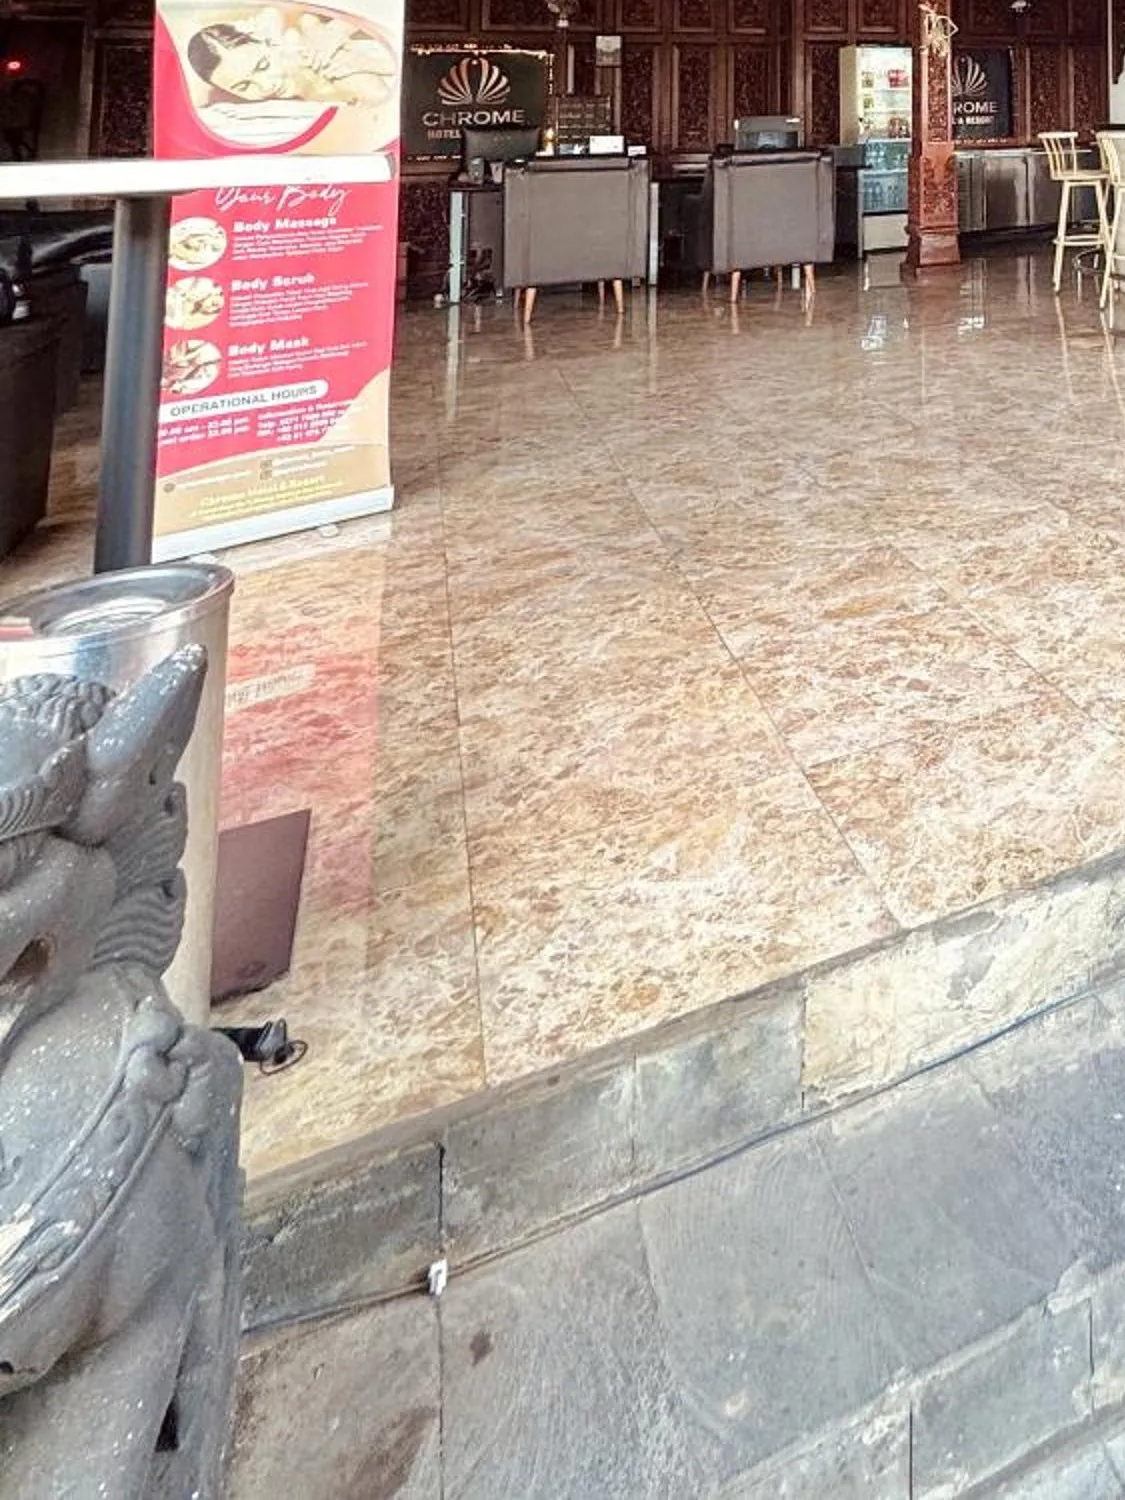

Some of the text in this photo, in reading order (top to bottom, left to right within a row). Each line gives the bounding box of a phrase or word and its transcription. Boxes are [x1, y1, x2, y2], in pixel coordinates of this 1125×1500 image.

[952, 100, 998, 115] ROME
[422, 109, 525, 127] CHROME
[233, 216, 337, 234] Body Massage
[231, 273, 315, 292] Body Scrub
[227, 337, 310, 357] Body Mask
[170, 385, 318, 417] OPERATIONAL HOURS
